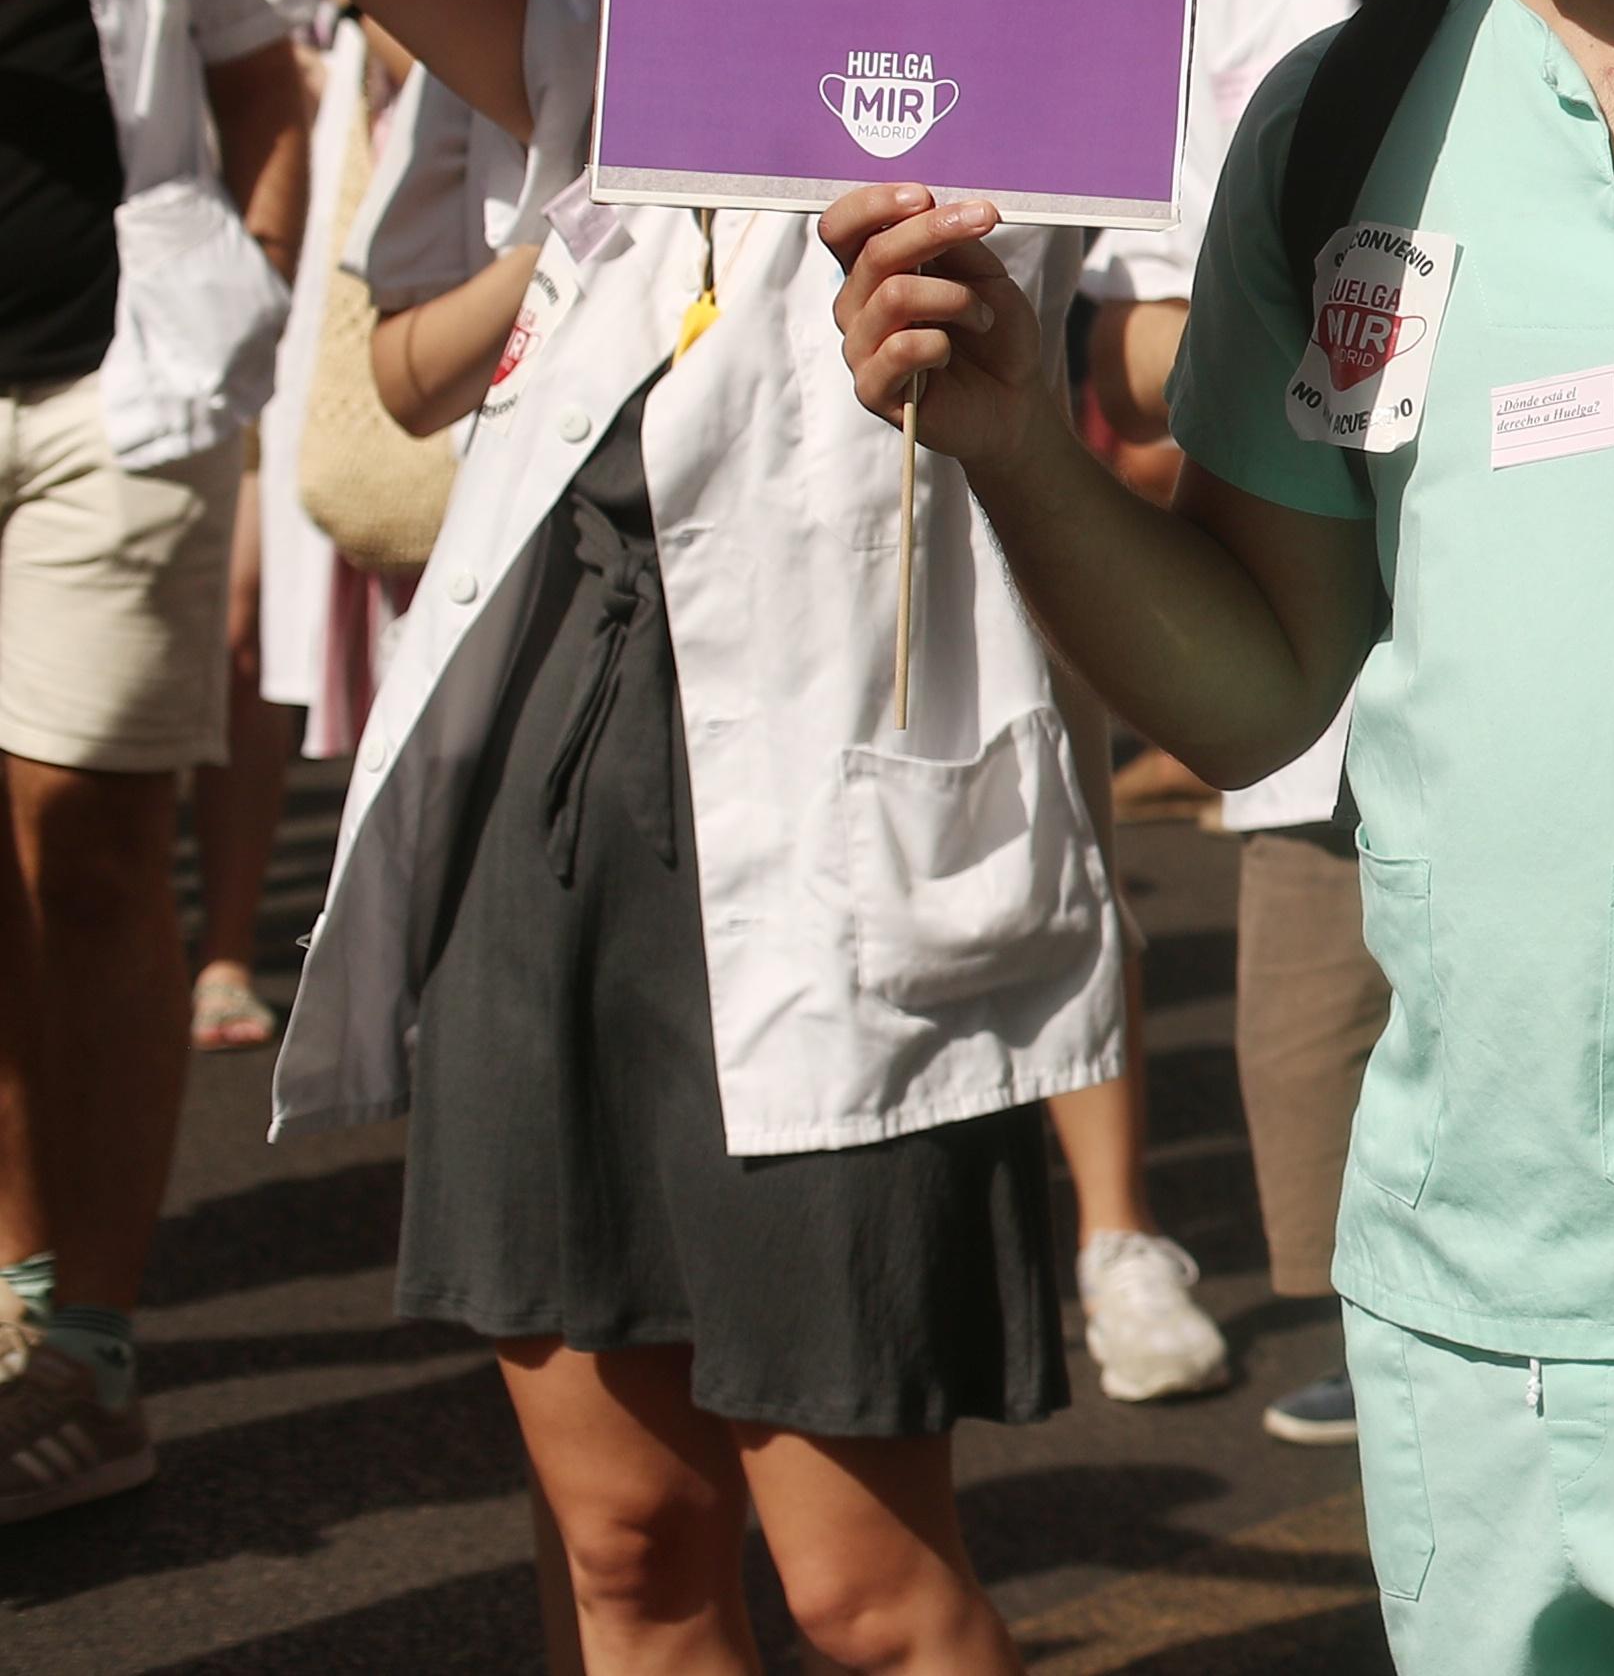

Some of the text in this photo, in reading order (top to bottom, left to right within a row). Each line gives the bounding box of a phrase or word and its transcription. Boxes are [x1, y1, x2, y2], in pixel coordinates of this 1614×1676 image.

[847, 51, 934, 80] HUELGA
[853, 85, 924, 125] MIR
[857, 123, 917, 140] MADRID
[1327, 309, 1393, 354] MIR
[1291, 381, 1322, 409] NO
[1497, 386, 1577, 416] ¿Dónde está el
[1497, 400, 1601, 433] derecho a Huelga?
